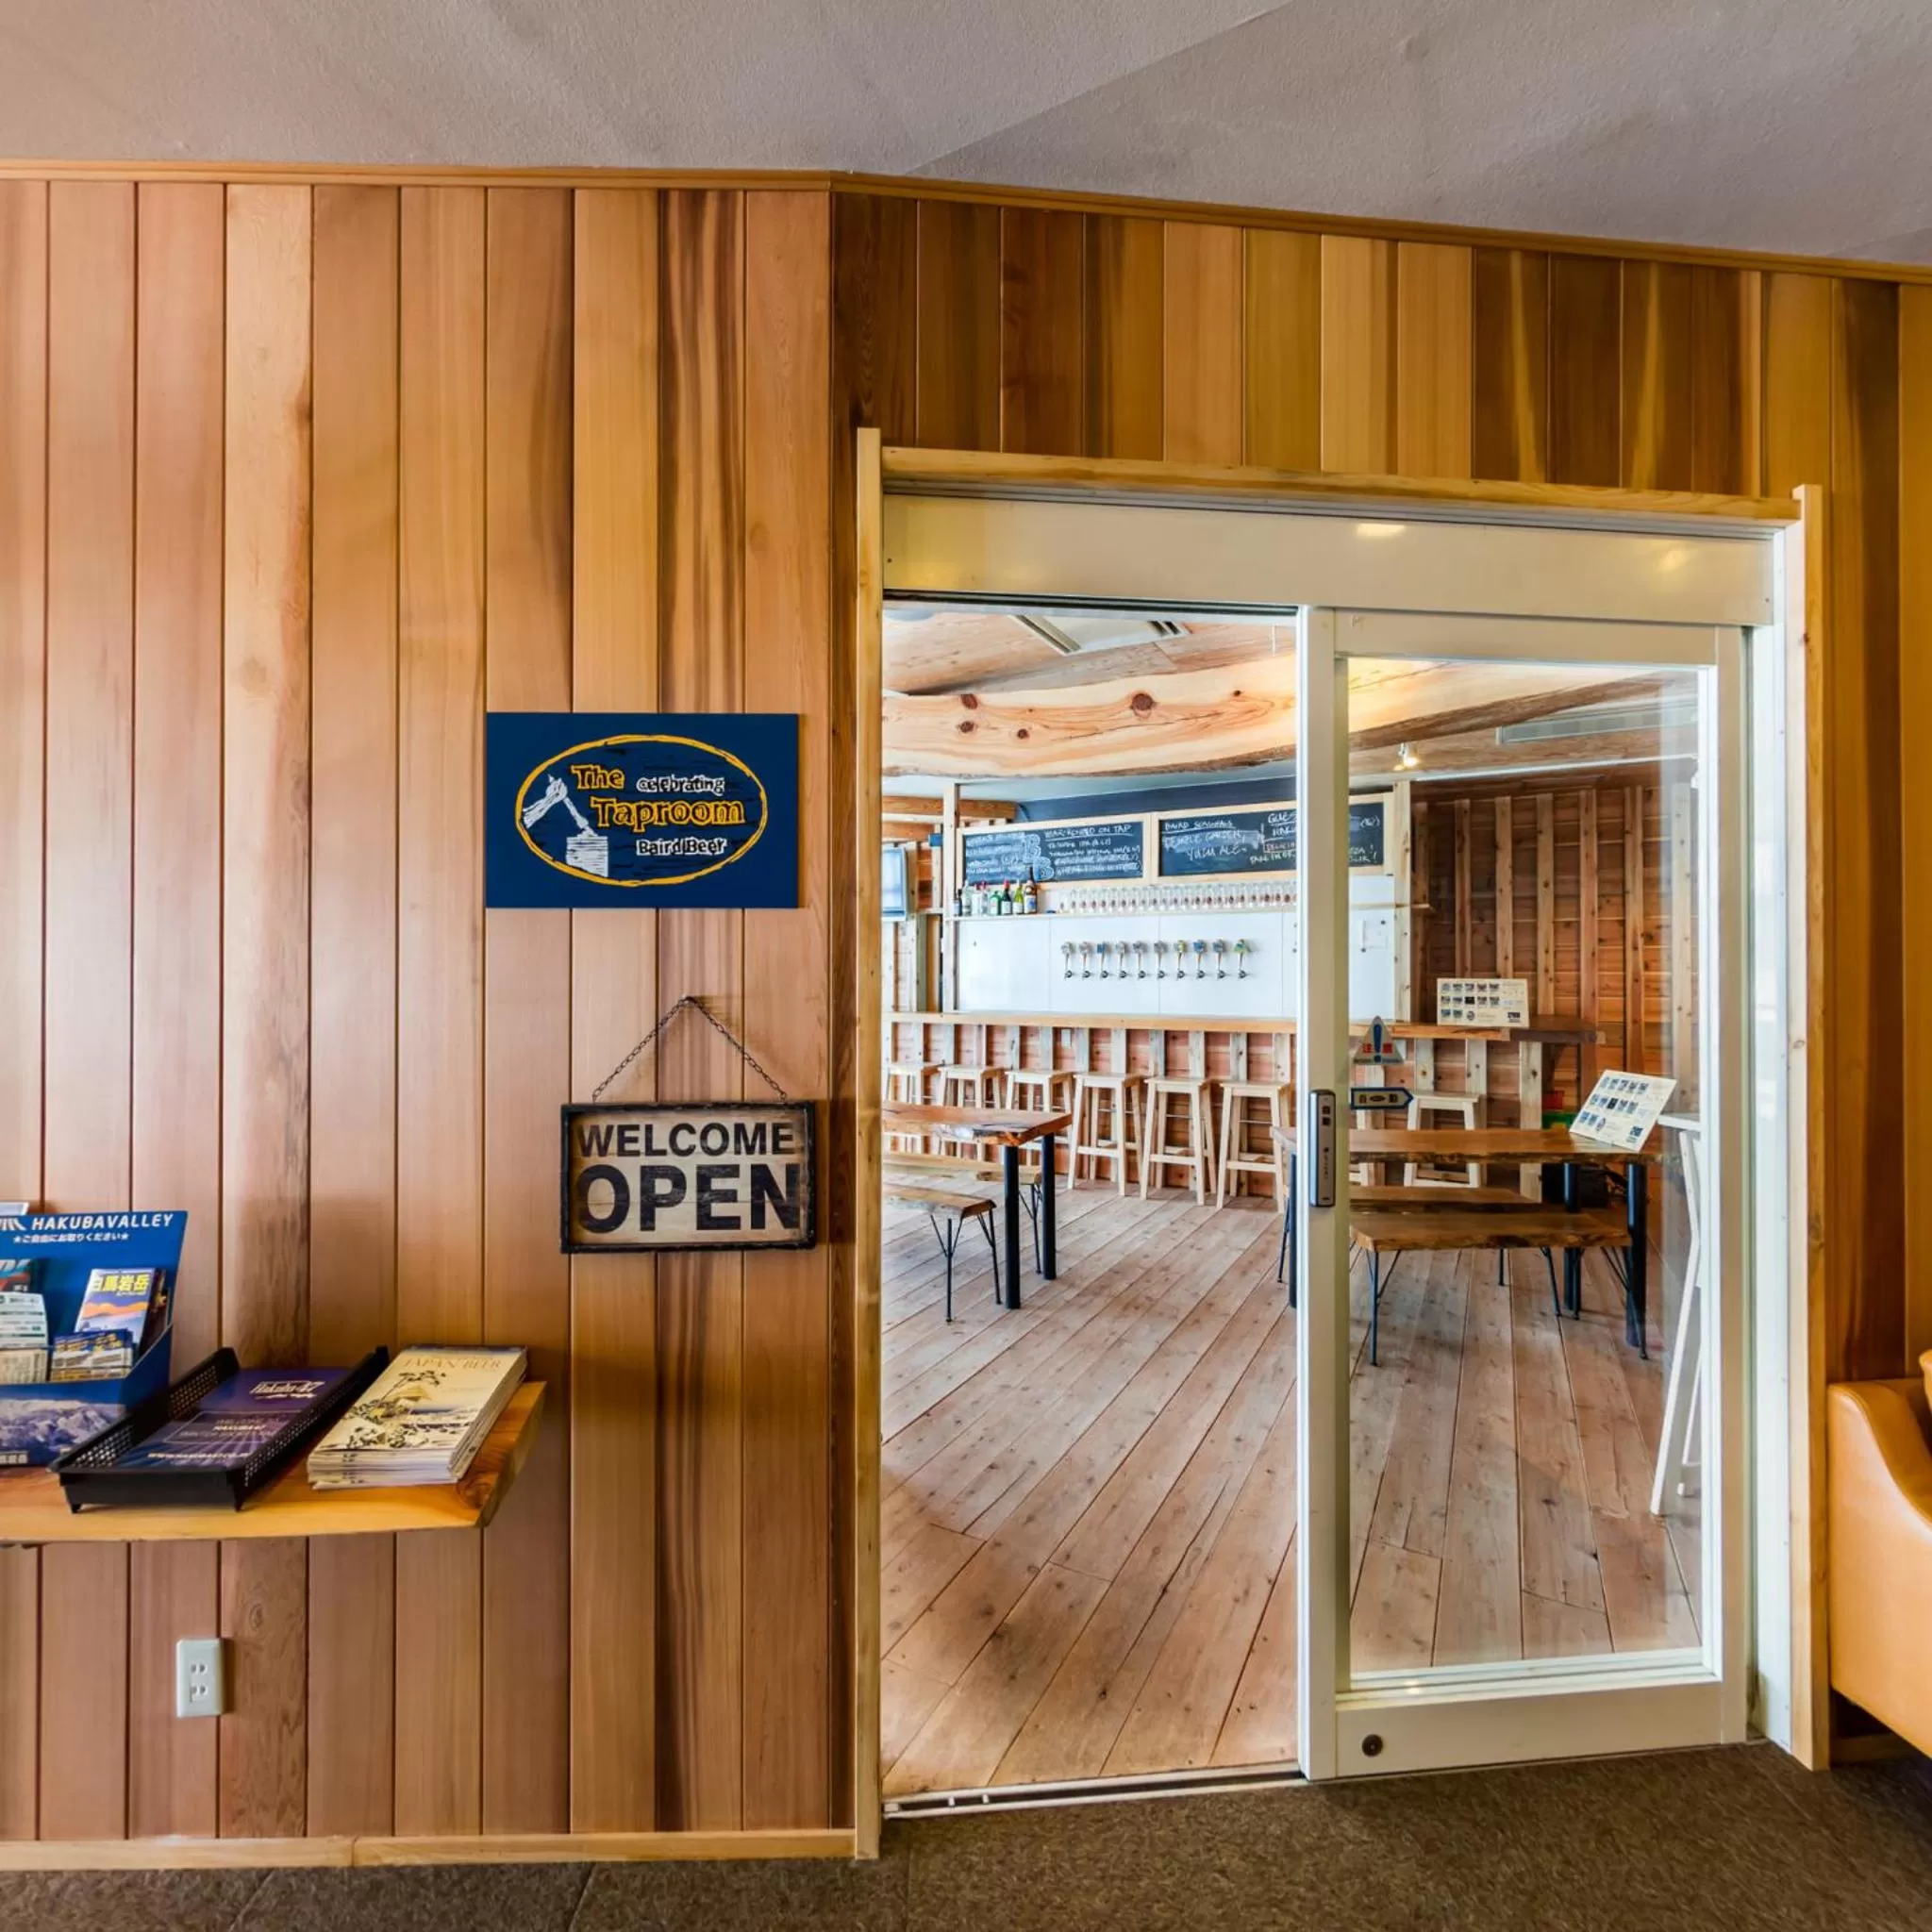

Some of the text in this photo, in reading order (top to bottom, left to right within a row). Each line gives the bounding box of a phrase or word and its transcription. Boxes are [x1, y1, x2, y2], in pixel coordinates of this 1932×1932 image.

[570, 764, 625, 790] The
[591, 796, 745, 831] Taproom
[1268, 811, 1296, 824] GUES
[636, 837, 727, 856] Baird Beer
[578, 1123, 795, 1157] WELCOME
[578, 1164, 801, 1234] OPEN
[31, 1213, 174, 1231] HAKUBAVALLEY
